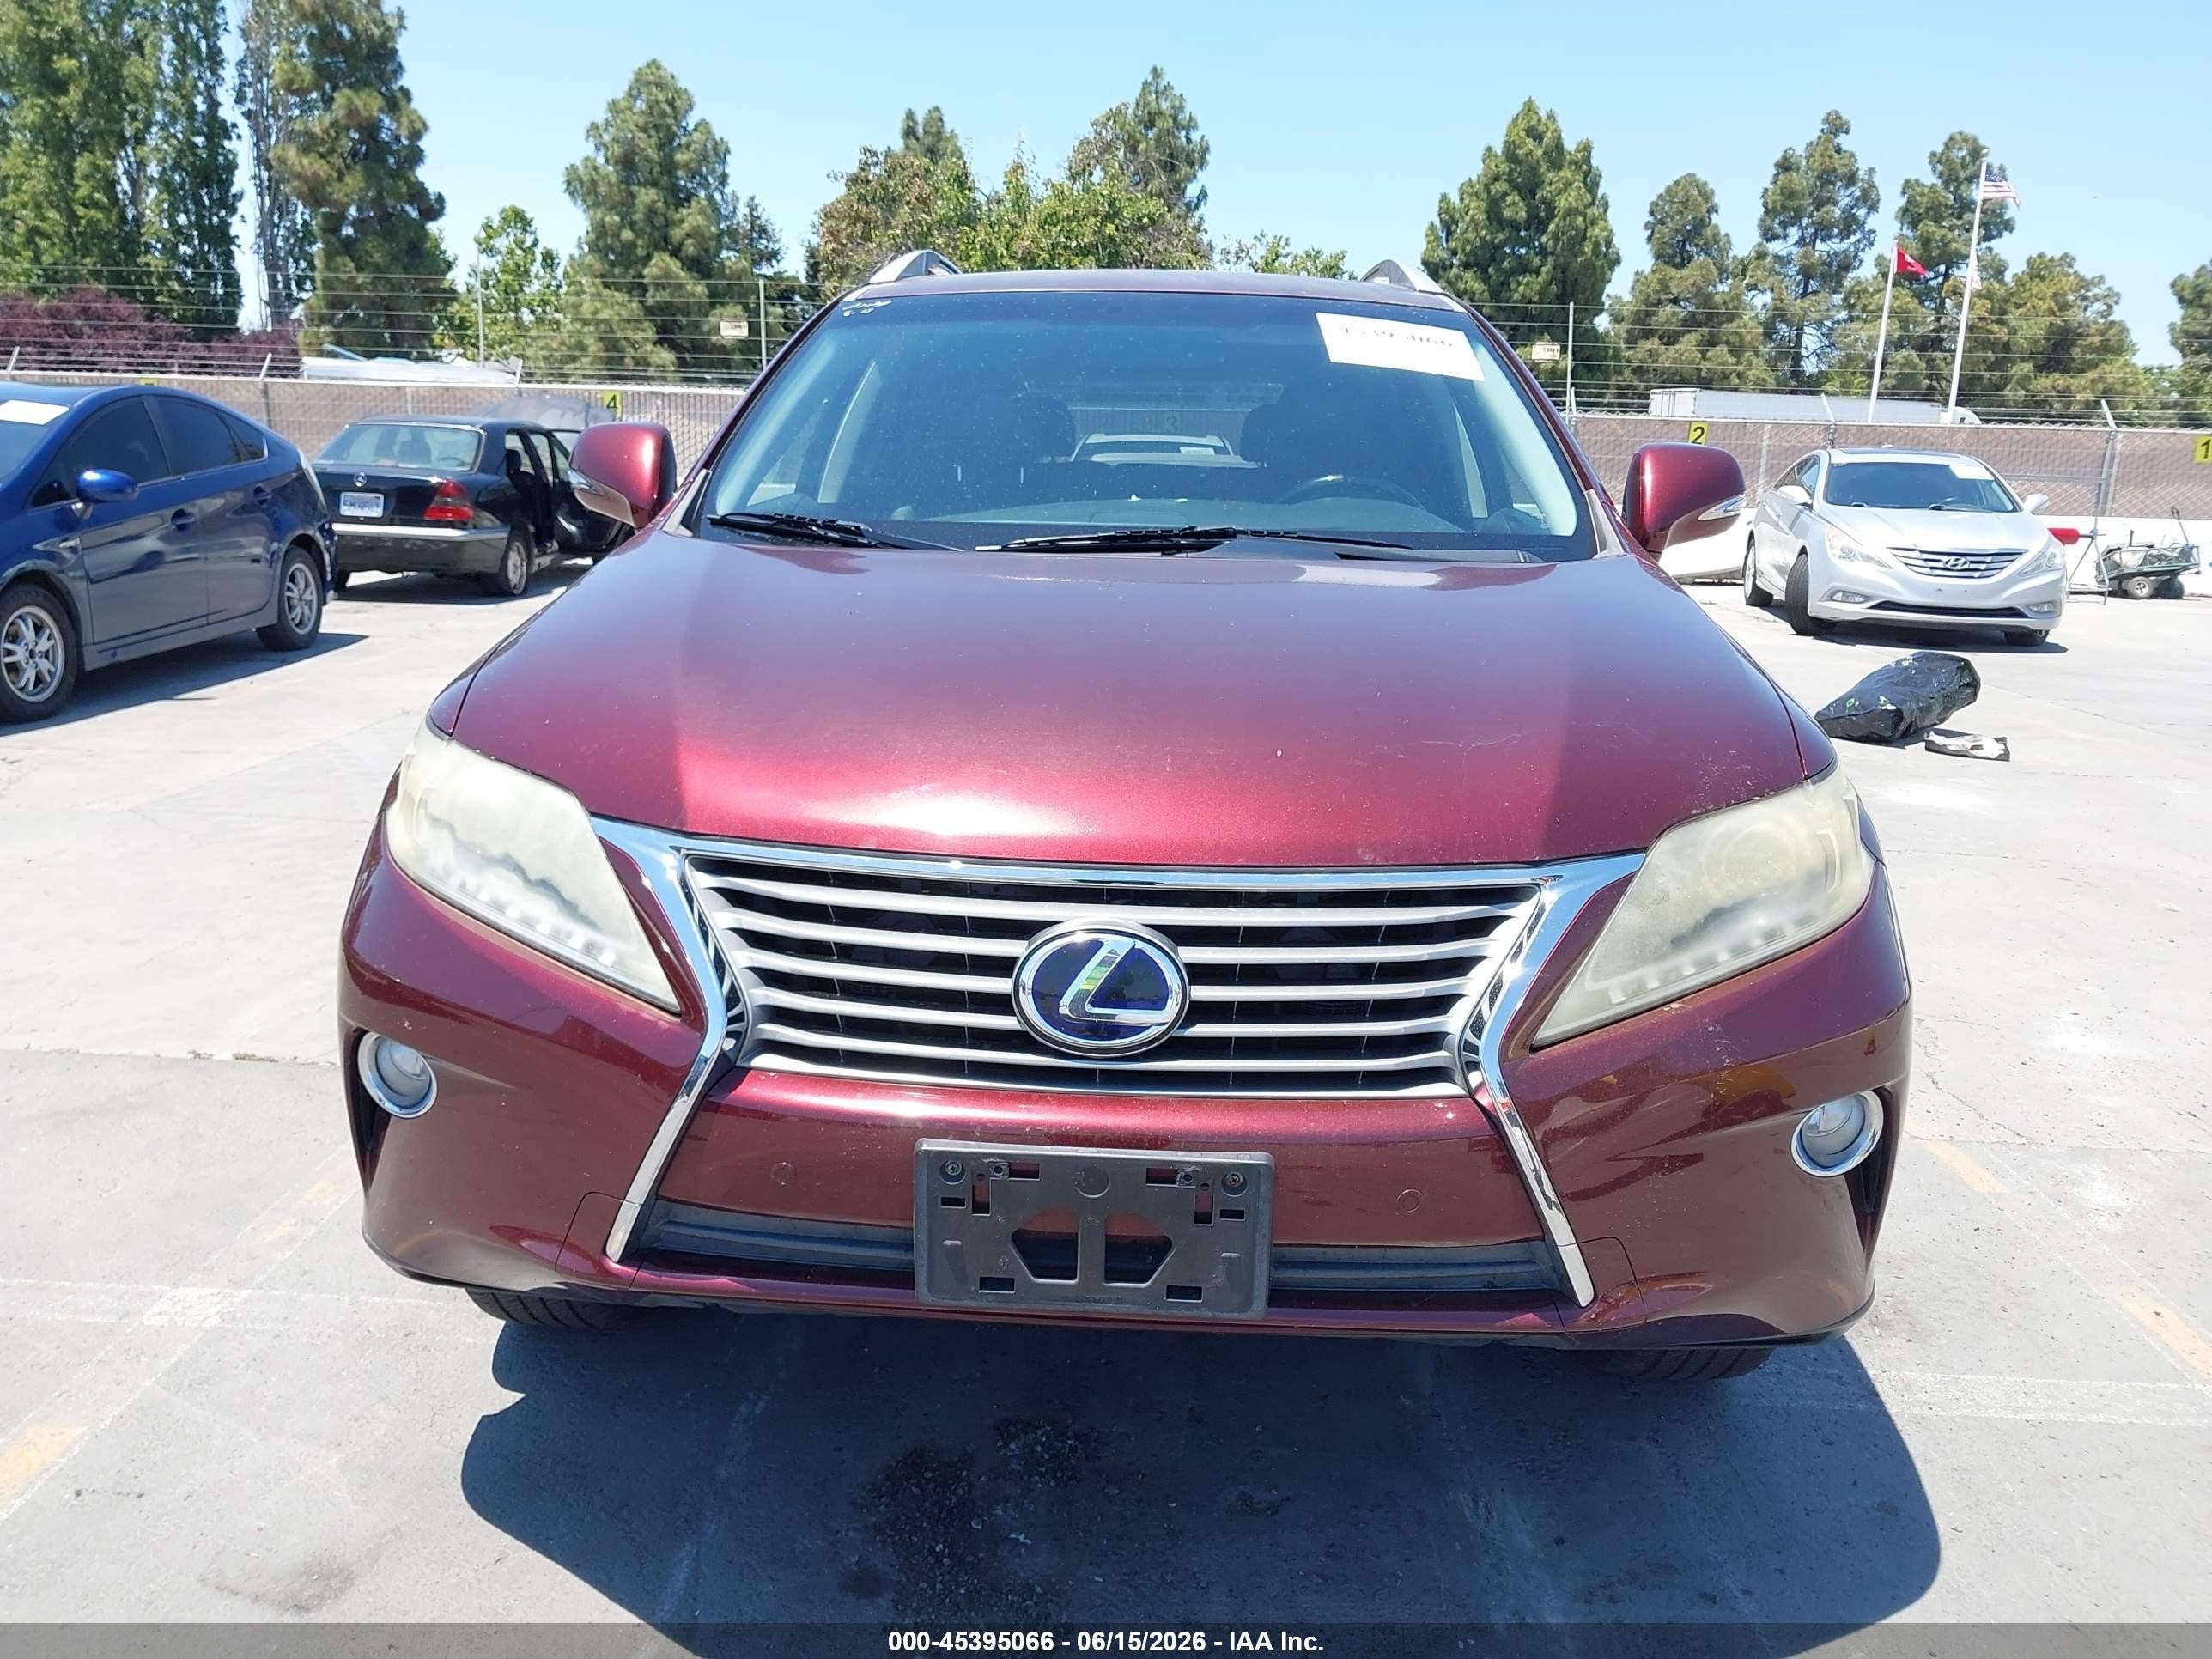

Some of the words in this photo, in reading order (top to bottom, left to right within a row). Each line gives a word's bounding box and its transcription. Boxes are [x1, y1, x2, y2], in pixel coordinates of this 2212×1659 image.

[605, 393, 618, 410] 4
[1691, 426, 1705, 445] 2
[2201, 439, 2211, 459] 1
